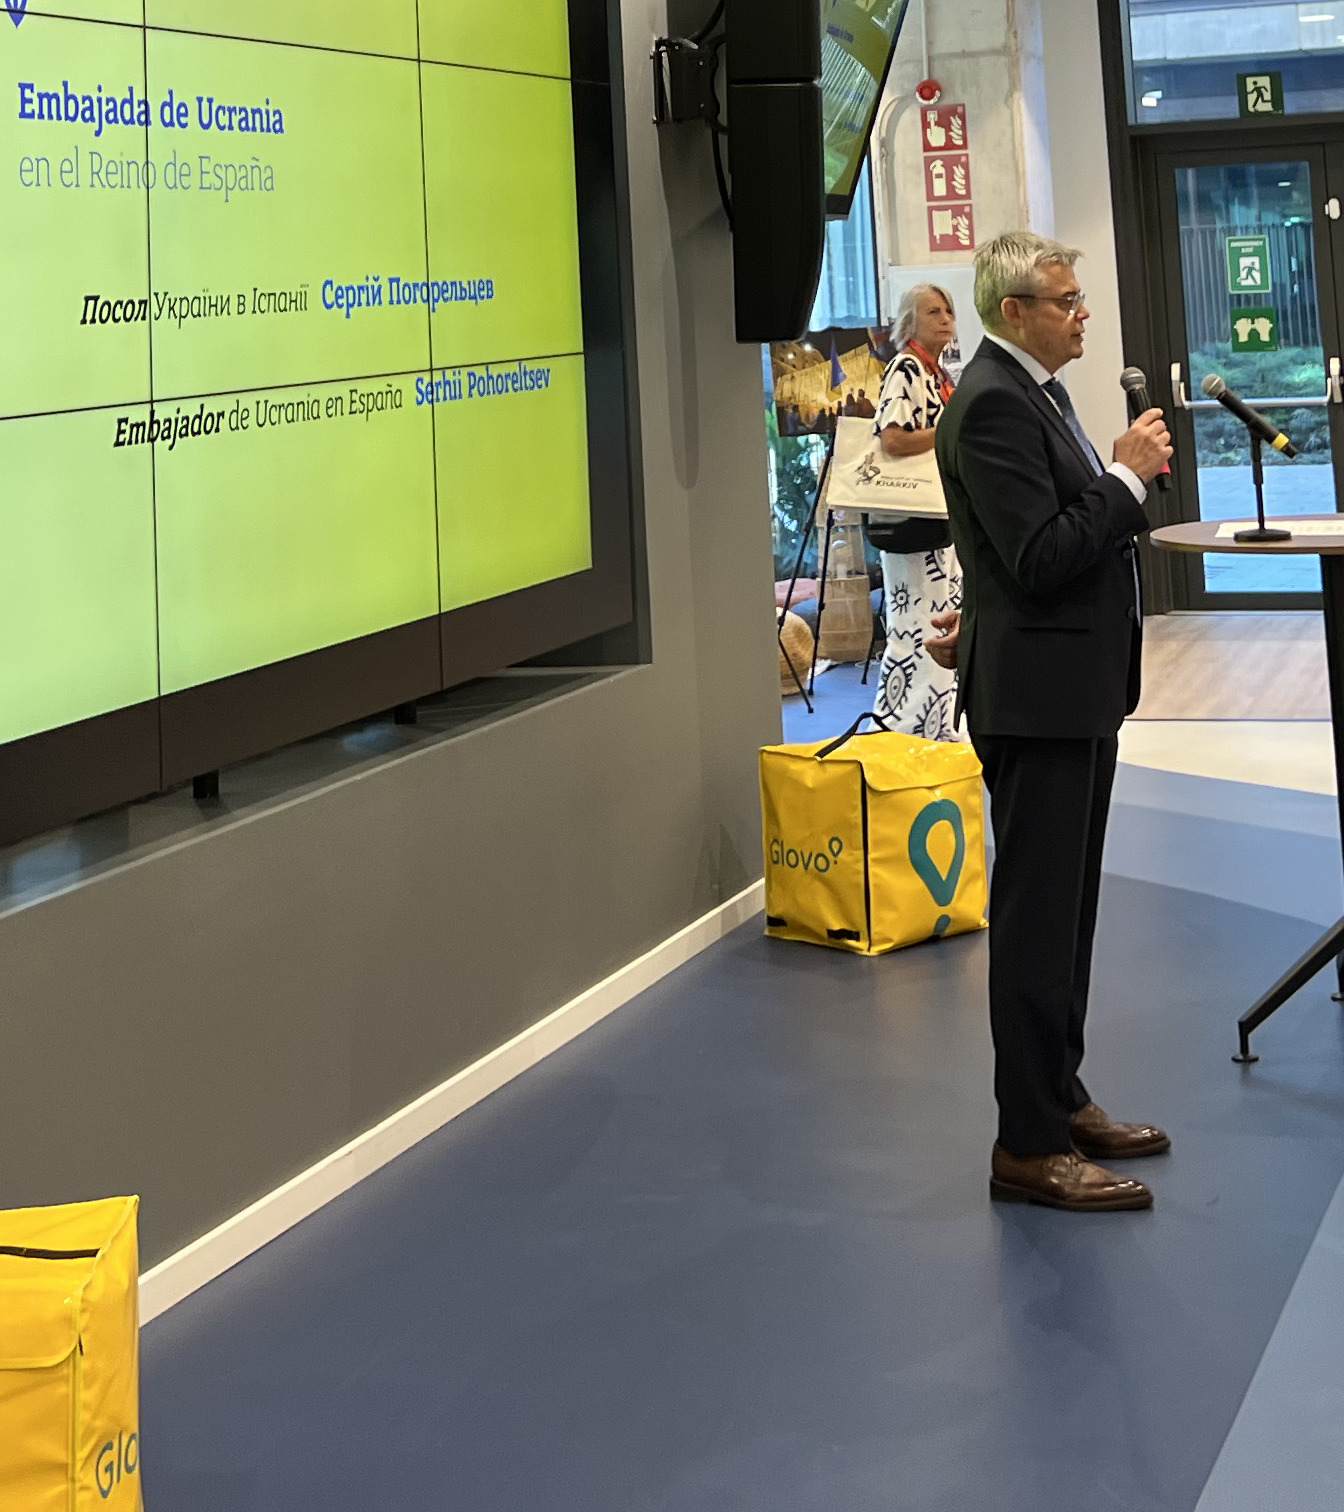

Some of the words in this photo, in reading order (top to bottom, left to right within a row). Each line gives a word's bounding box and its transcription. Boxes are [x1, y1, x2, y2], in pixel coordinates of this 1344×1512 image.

[18, 82, 152, 136] Embajada
[160, 89, 189, 128] de
[197, 96, 285, 134] Ucrania
[19, 155, 51, 188] en
[60, 146, 81, 188] el
[90, 151, 157, 190] Reino
[163, 150, 192, 191] de
[198, 155, 275, 202] España
[80, 294, 149, 326] Посол
[153, 288, 231, 329] України
[236, 296, 247, 316] в
[251, 284, 309, 316] Іспанії
[321, 274, 384, 319] Сергій
[388, 276, 495, 313] Погорельцев
[113, 408, 225, 450] Embajador
[228, 397, 250, 432] de
[255, 391, 321, 429] Ucrania
[325, 395, 345, 419] en
[349, 384, 403, 422] España
[415, 371, 463, 407] Serhii
[467, 362, 551, 400] Pohoreltsev
[770, 838, 830, 873] Glovo
